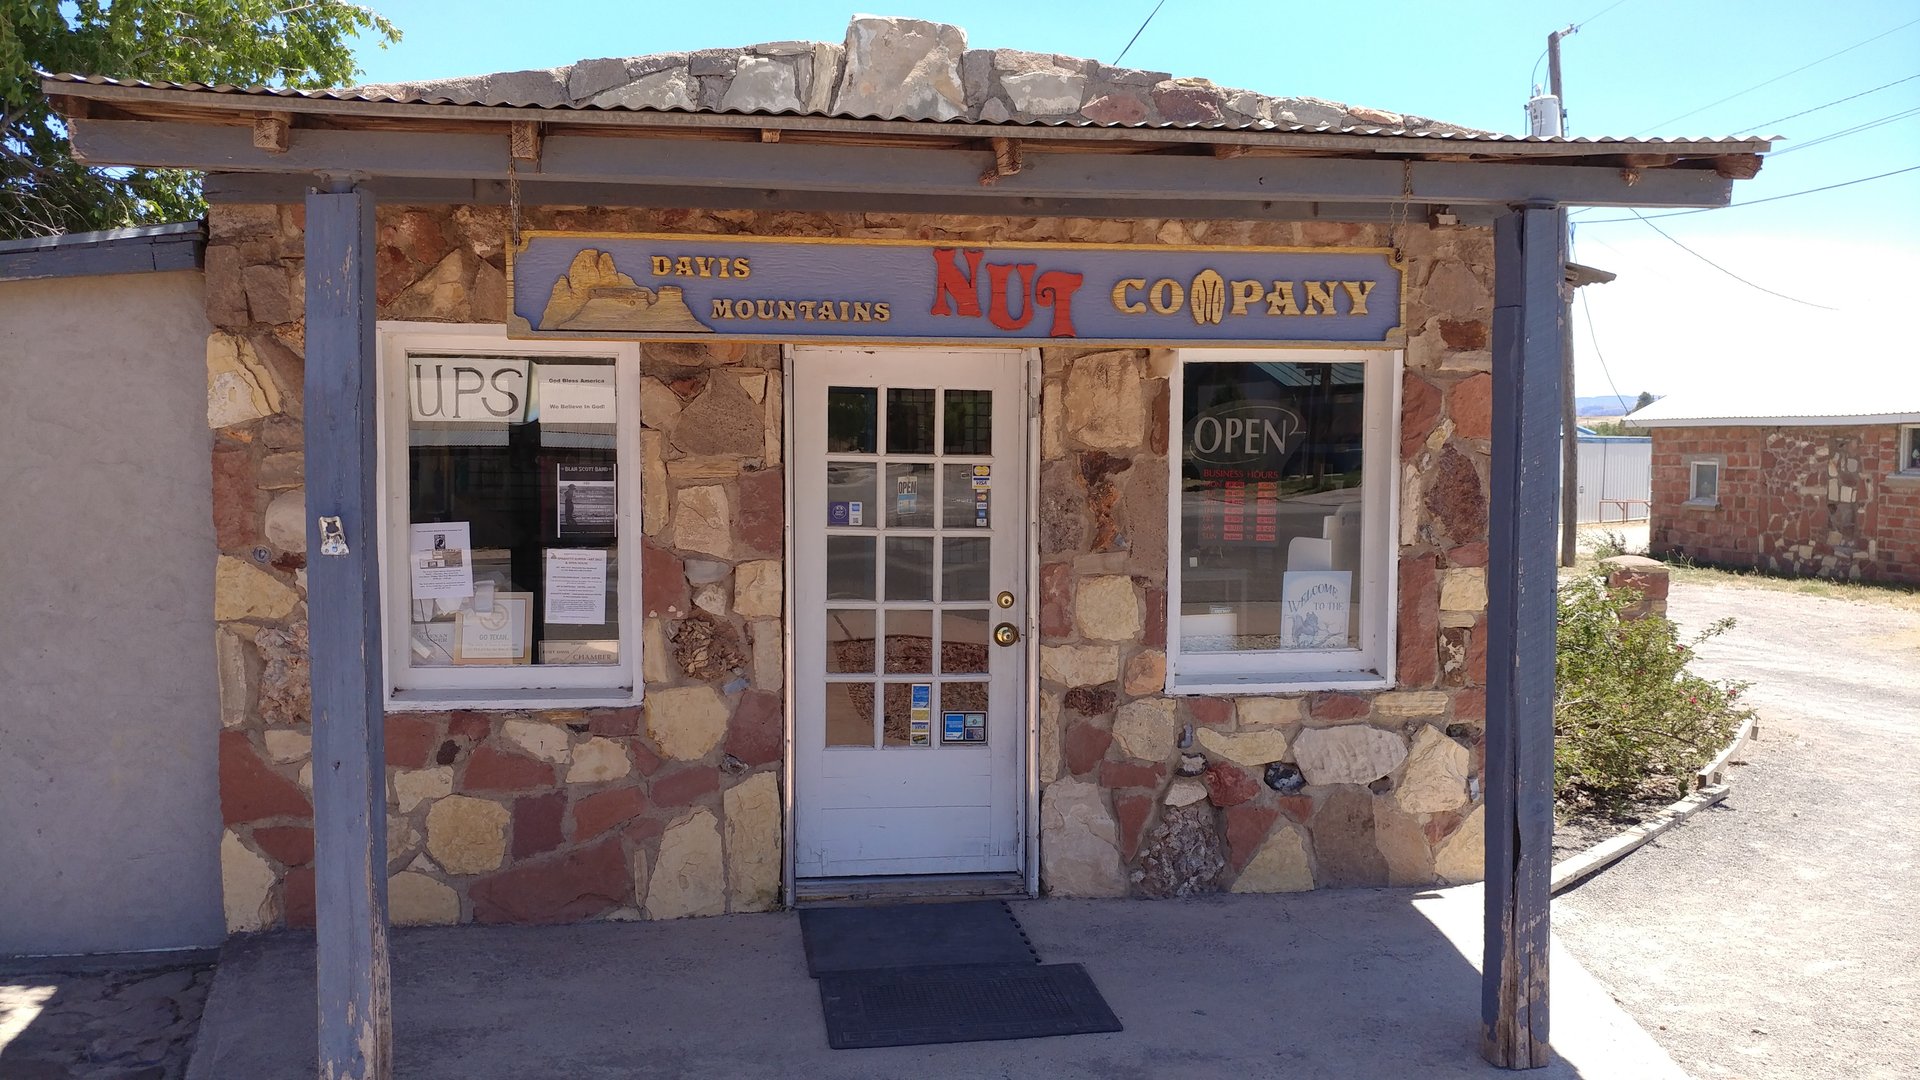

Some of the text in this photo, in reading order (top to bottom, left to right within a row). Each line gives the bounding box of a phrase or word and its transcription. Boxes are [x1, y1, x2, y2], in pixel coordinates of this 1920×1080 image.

[650, 255, 751, 279] DAVIS
[930, 247, 1084, 338] NUT
[711, 298, 891, 323] MOUNTAINS
[415, 364, 523, 418] UPS
[1194, 416, 1287, 455] OPEN
[1203, 469, 1279, 478] BUSINESS HOURS
[898, 481, 917, 494] OPEN
[1288, 583, 1338, 613] WELCOME
[1315, 602, 1344, 611] TO THE
